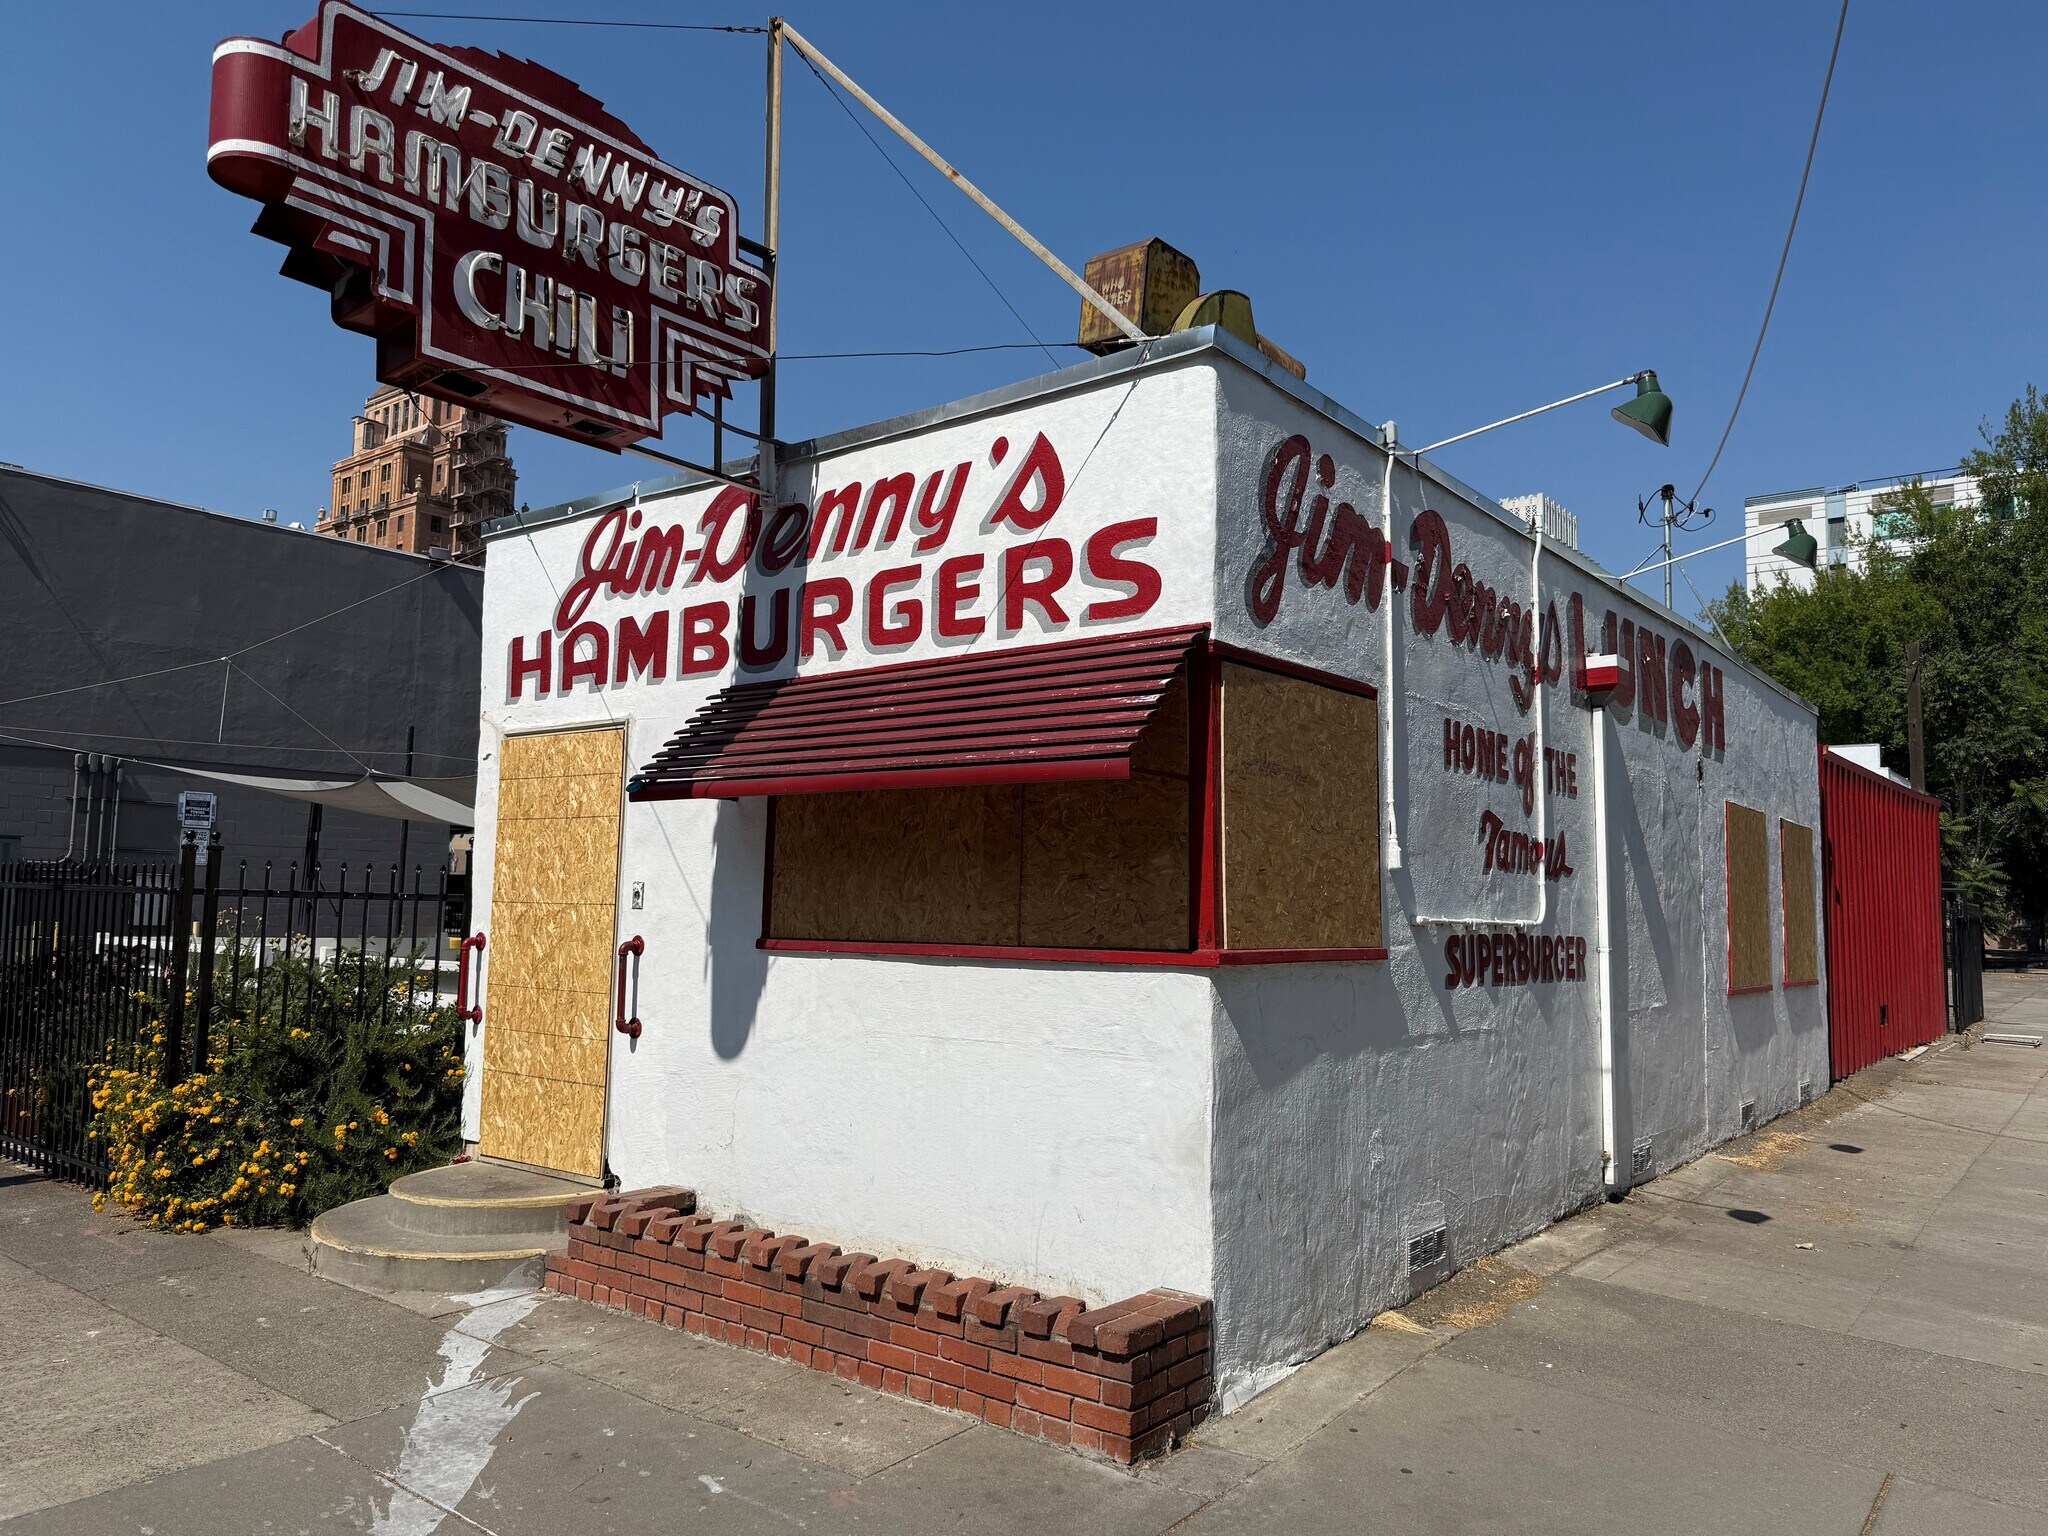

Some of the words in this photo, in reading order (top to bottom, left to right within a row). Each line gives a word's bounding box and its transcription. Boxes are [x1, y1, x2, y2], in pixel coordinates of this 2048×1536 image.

[287, 75, 760, 333] HAMBURGERS
[347, 47, 724, 248] JIM-DENNY'S
[508, 516, 1162, 702] HAMBURGERS
[556, 431, 1065, 630] Jim-Denny's
[1444, 718, 1509, 782] HOME
[1514, 731, 1536, 816] of
[1544, 747, 1578, 799] THE
[1445, 933, 1587, 989] SUPERBURGER
